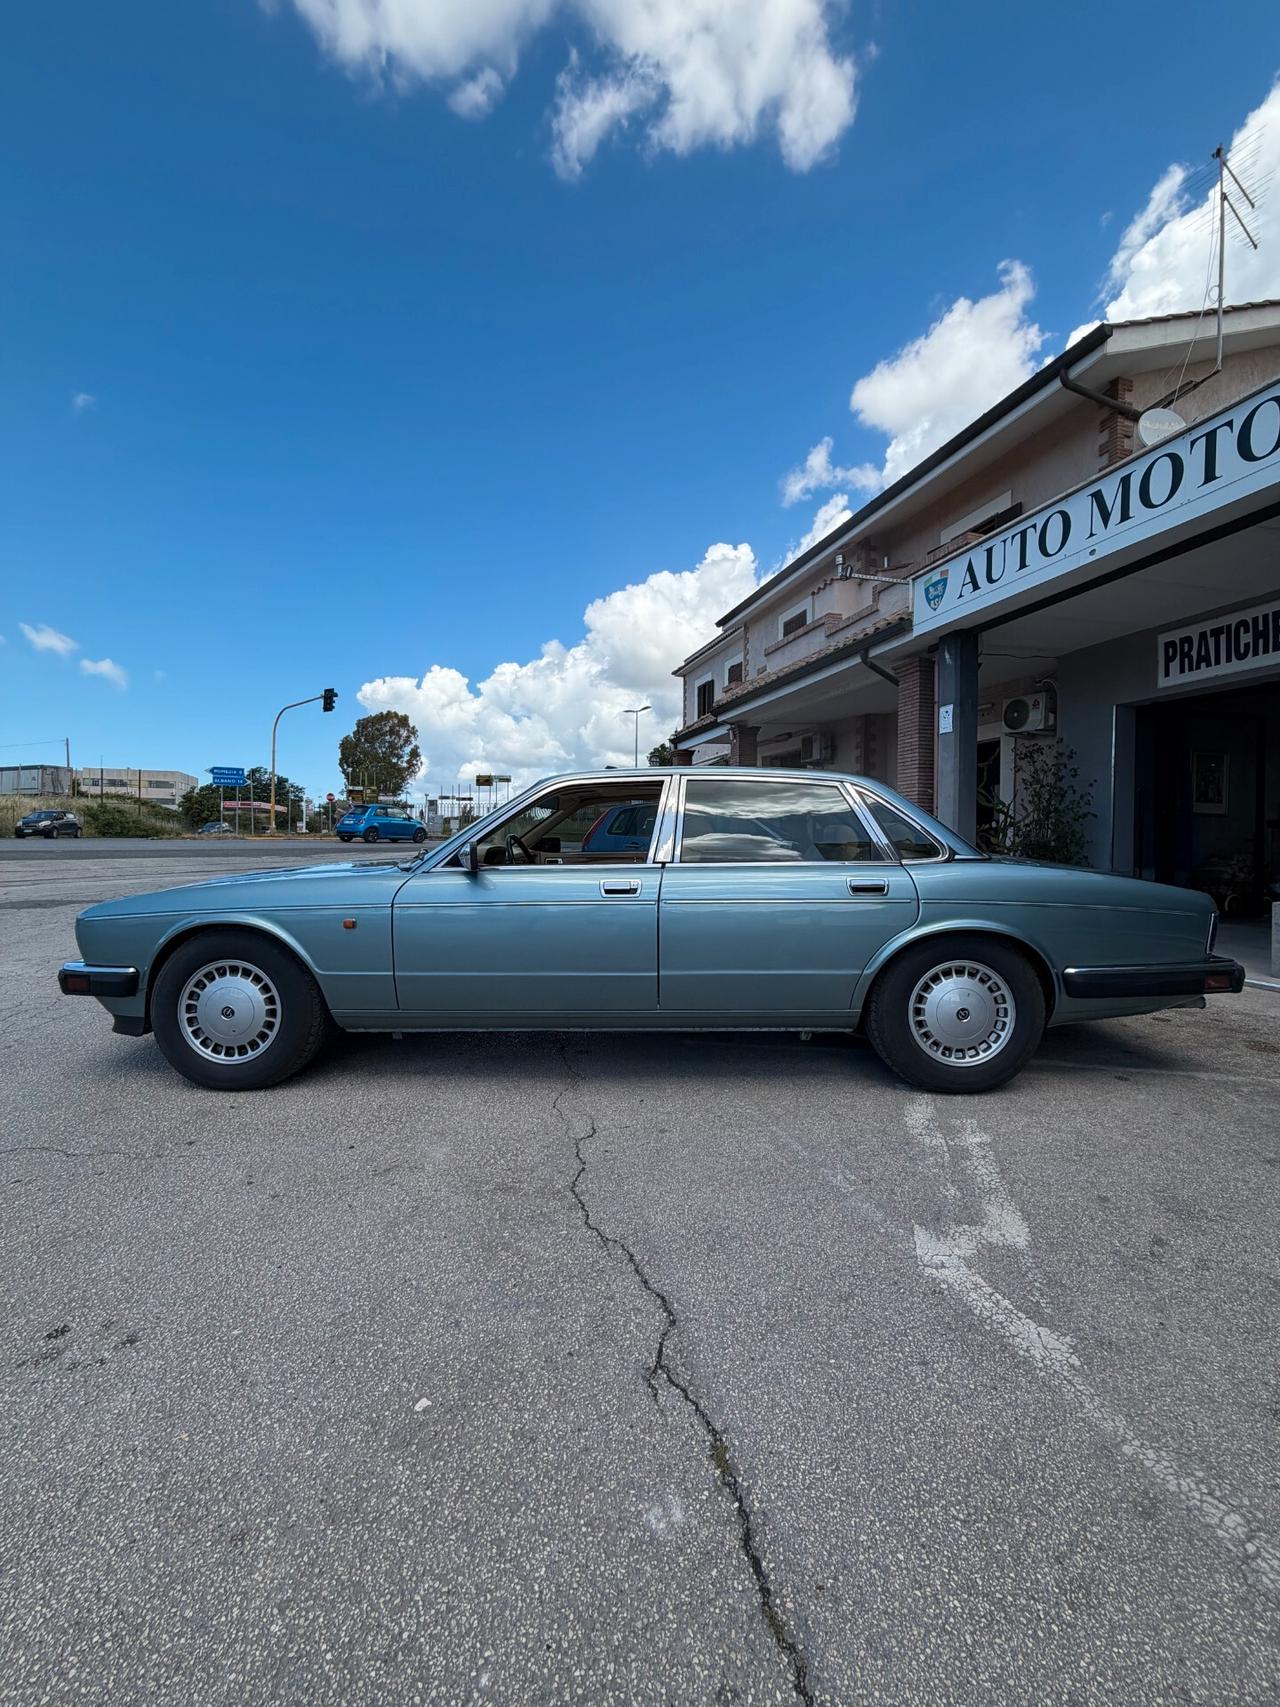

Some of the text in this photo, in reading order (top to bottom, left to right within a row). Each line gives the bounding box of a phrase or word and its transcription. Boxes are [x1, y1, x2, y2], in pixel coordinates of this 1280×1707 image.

[957, 394, 1280, 600] AUTO MOTO
[1163, 609, 1280, 678] PRATICHE
